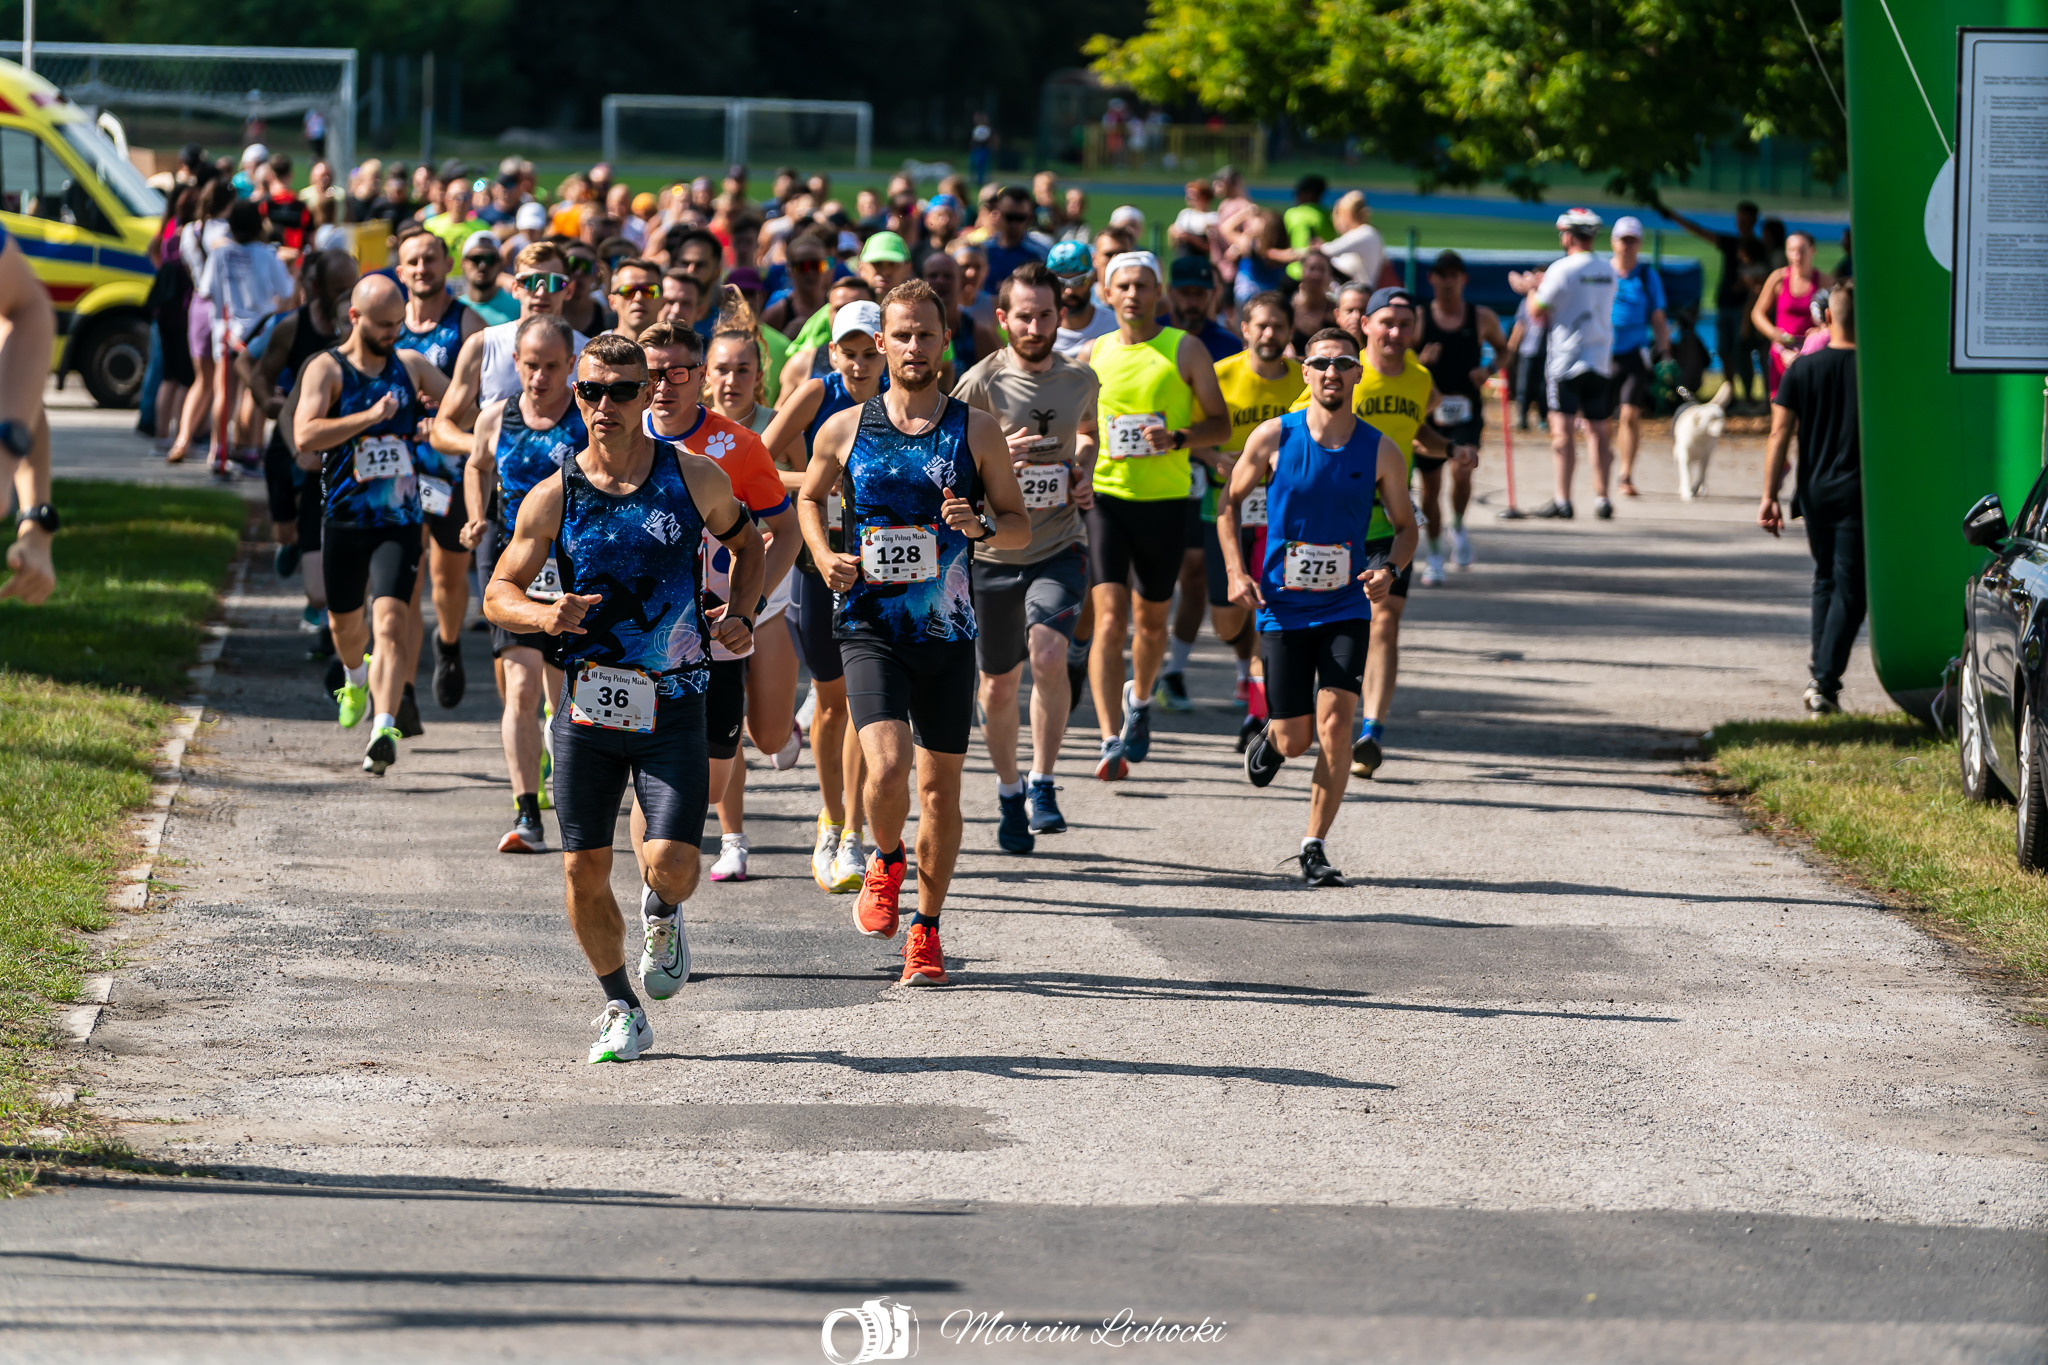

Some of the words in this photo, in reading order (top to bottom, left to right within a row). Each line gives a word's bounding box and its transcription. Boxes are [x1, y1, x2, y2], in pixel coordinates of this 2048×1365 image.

[1119, 428, 1141, 443] 25
[366, 448, 400, 465] 125
[1023, 478, 1058, 494] 296
[877, 545, 921, 564] 128
[1299, 559, 1337, 575] 275
[599, 672, 612, 683] Bieg
[631, 676, 648, 686] Miski
[597, 686, 629, 709] 36
